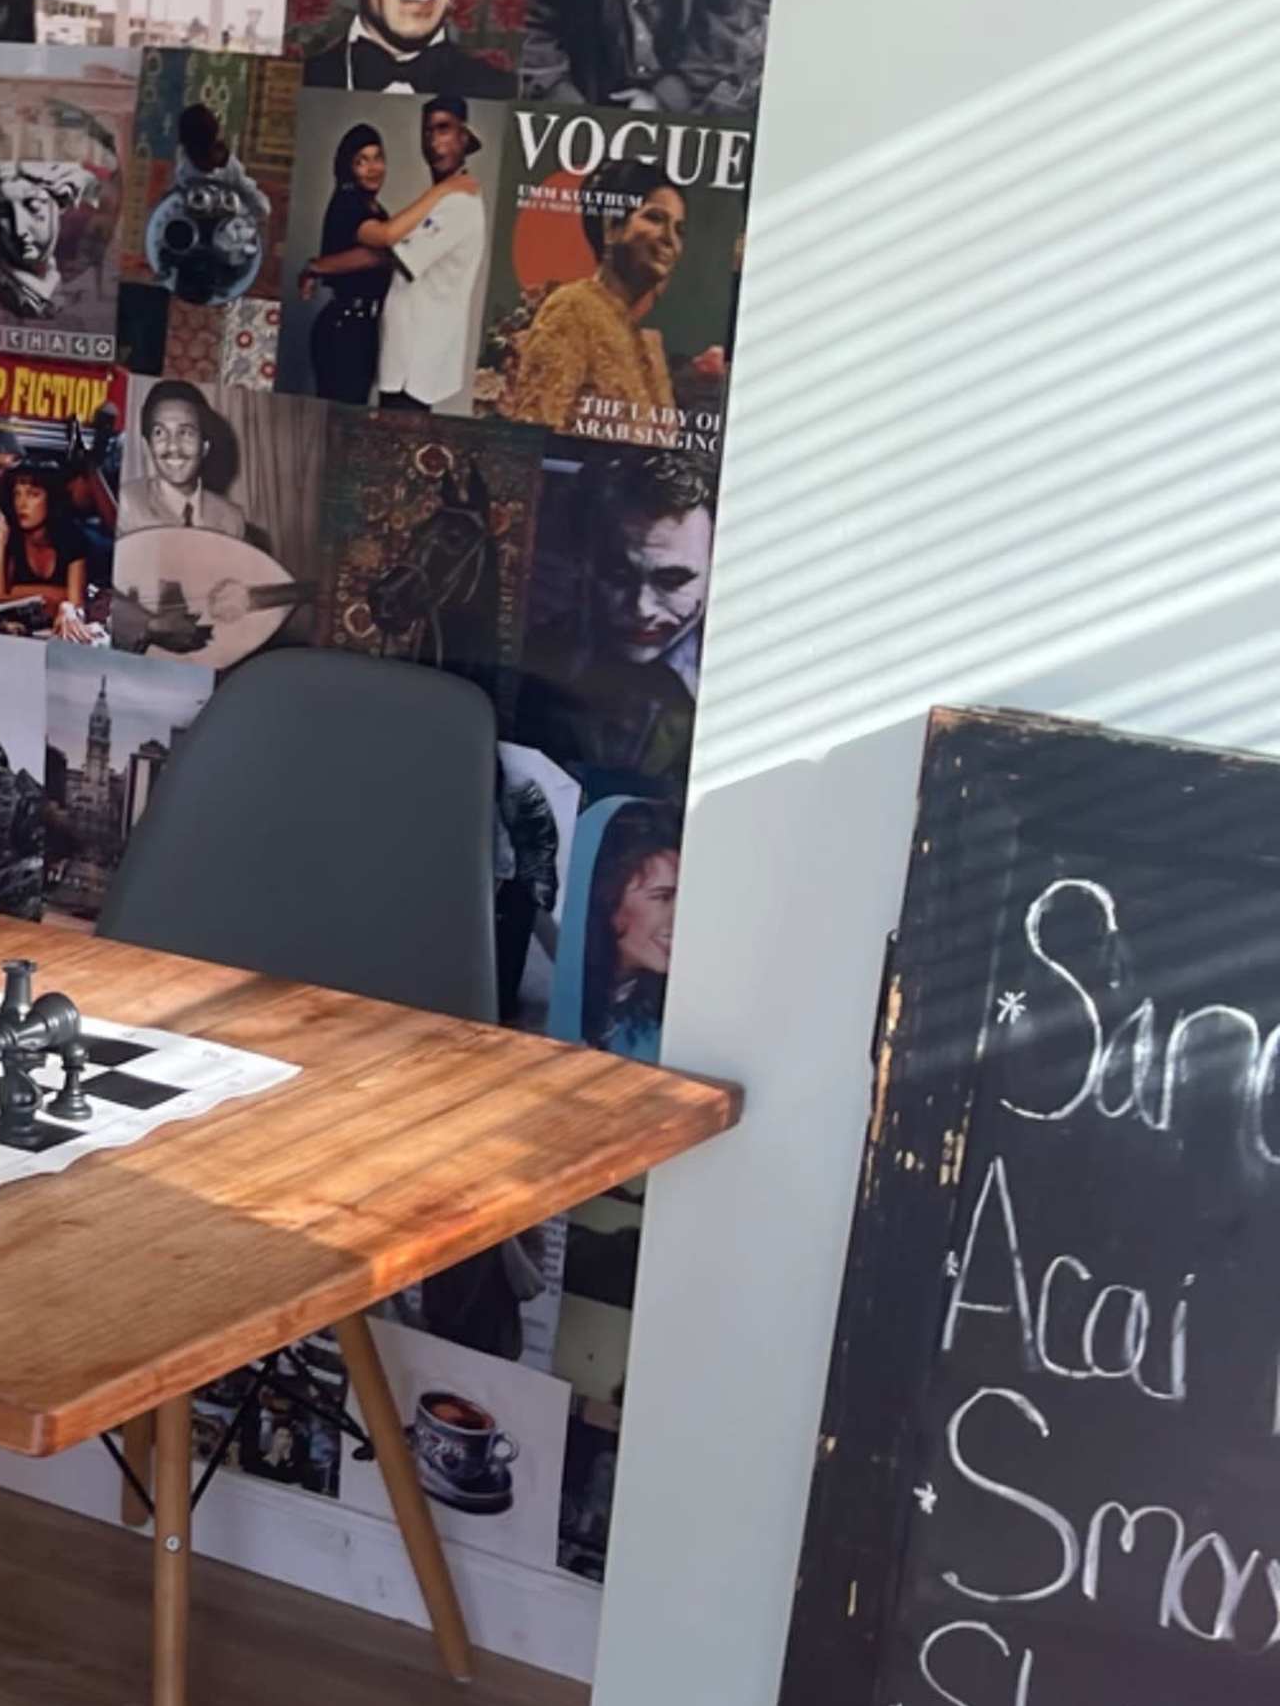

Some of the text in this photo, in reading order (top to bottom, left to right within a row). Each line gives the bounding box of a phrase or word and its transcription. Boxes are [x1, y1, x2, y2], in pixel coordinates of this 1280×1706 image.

[515, 111, 751, 189] VOGUE
[517, 184, 559, 203] UMM
[11, 365, 108, 424] FICTION
[580, 395, 625, 418] THE
[630, 402, 689, 427] LADY
[573, 418, 630, 440] ARAB
[942, 1155, 1196, 1402] Acai
